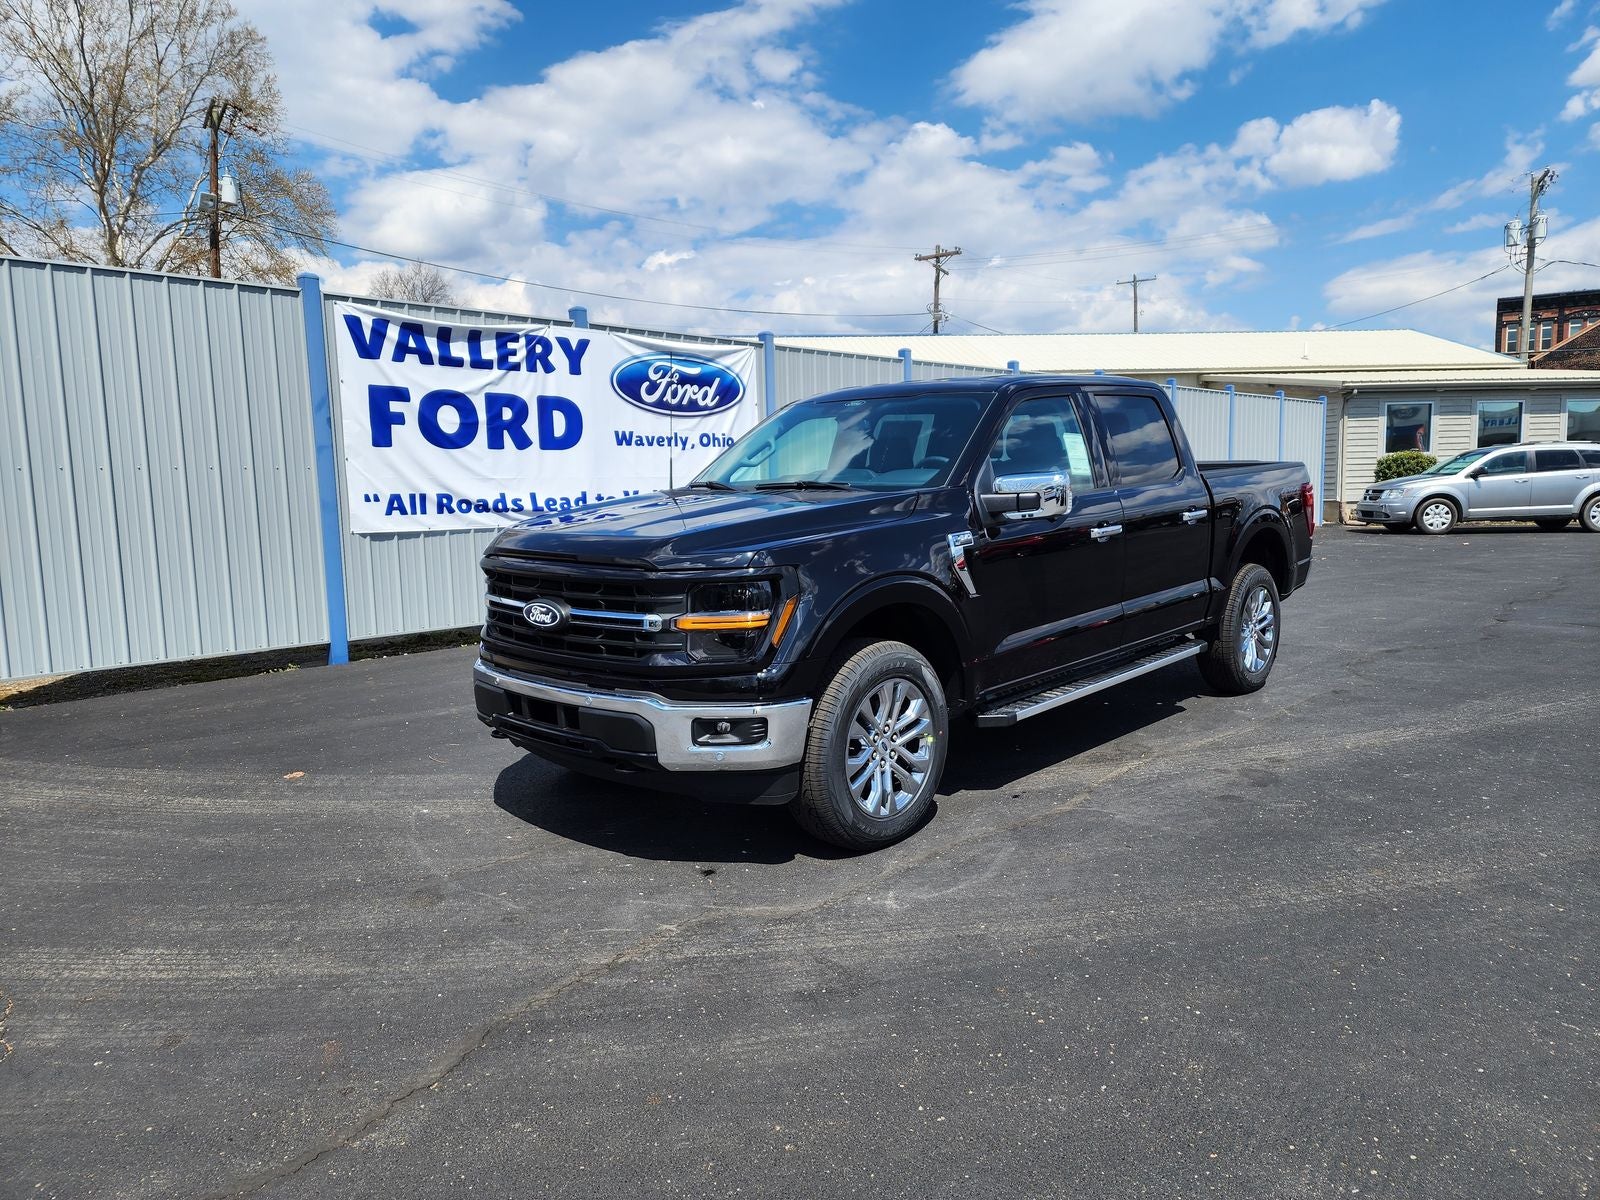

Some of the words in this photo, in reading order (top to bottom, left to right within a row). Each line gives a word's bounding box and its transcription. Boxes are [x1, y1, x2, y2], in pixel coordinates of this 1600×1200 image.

[342, 314, 591, 375] VALLERY
[640, 361, 721, 406] Ford
[368, 384, 583, 450] FORD
[614, 430, 695, 451] Waverly,
[699, 432, 735, 448] Ohio
[436, 492, 525, 514] Roads
[529, 490, 587, 512] Lead
[529, 605, 552, 623] Ford
